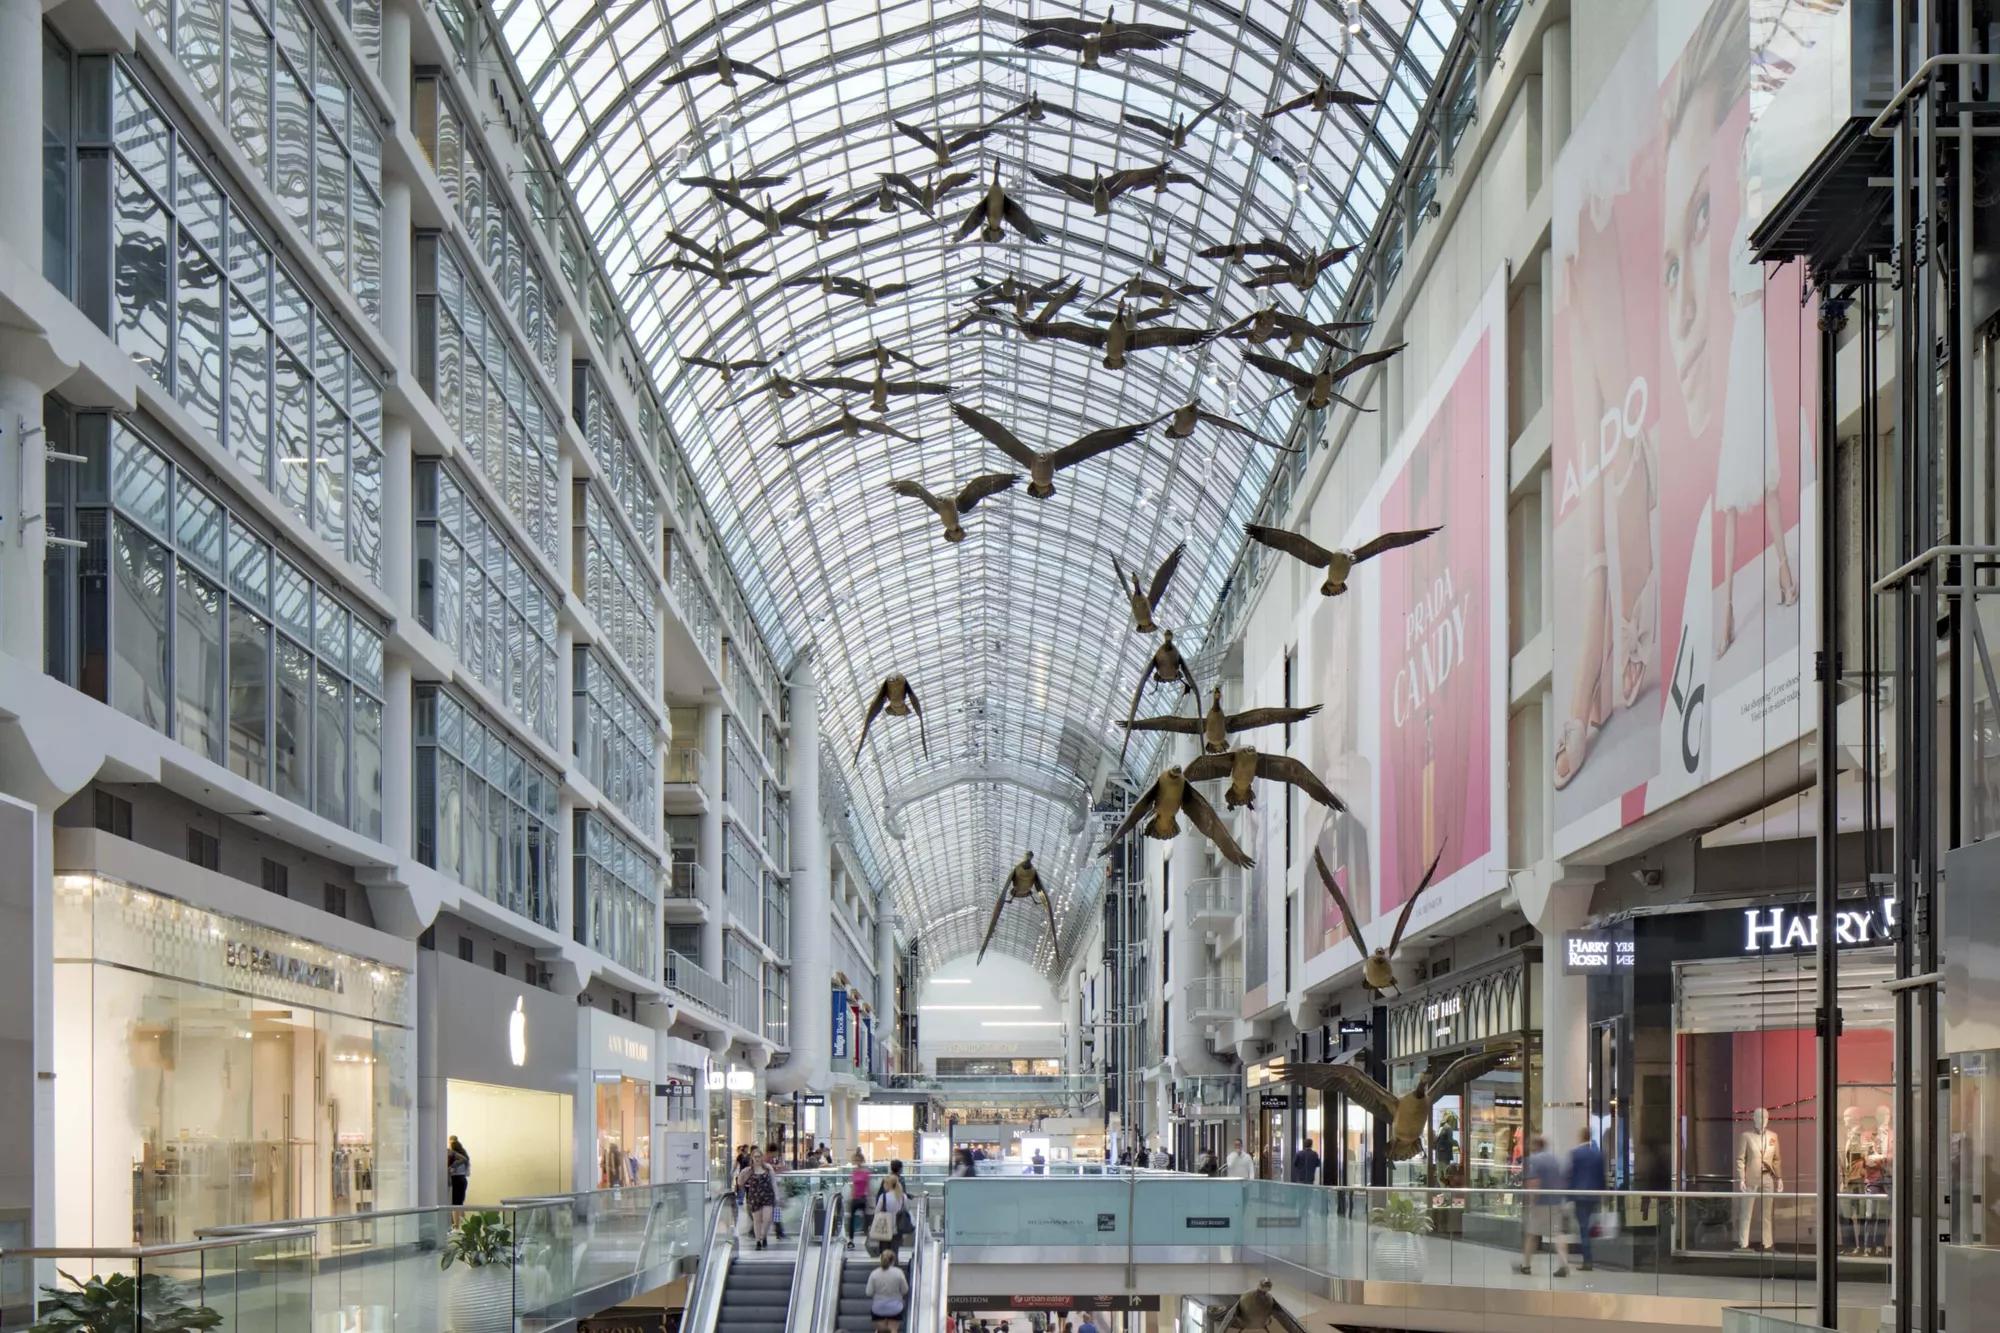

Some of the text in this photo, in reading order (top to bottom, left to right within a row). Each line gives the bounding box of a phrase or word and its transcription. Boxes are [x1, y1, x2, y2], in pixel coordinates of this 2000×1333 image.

[1559, 376, 1648, 516] ALDO
[1406, 568, 1453, 651] PRADA
[1393, 591, 1470, 727] CANDY
[1568, 938, 1610, 953] HARRY
[1568, 952, 1608, 966] ROSEN
[1427, 996, 1461, 1022] TED BAKER
[833, 1012, 845, 1056] Indigo Books
[1047, 1295, 1071, 1304] eatery
